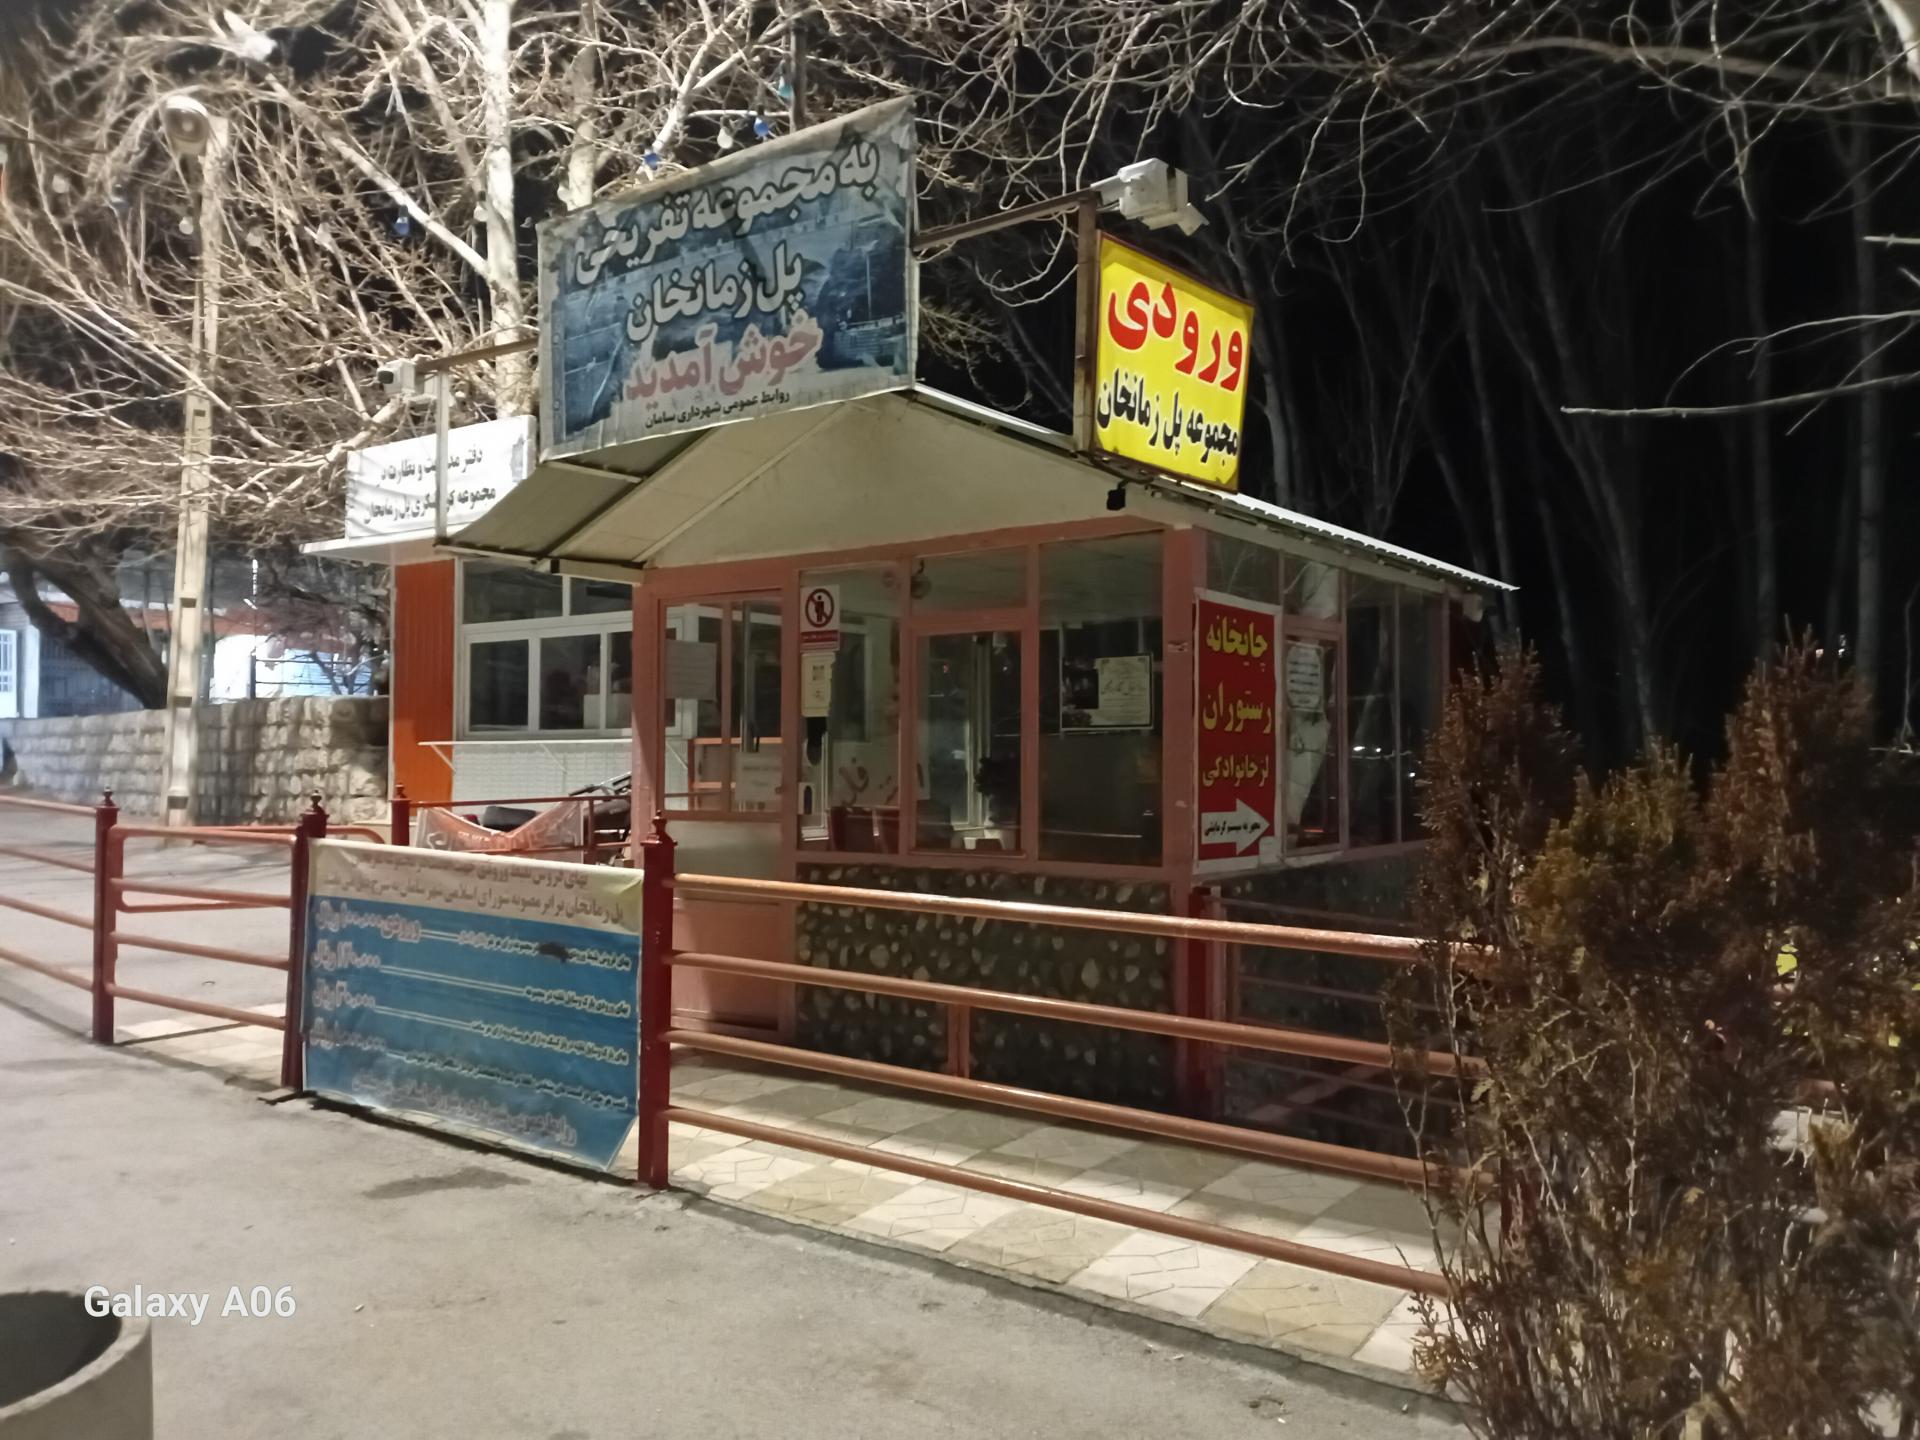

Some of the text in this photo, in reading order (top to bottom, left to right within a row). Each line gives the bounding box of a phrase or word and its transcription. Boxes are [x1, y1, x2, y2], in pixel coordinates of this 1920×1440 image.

[574, 140, 881, 285] به مجموعه تفریحی
[626, 240, 804, 344] پل زمانخان
[623, 306, 823, 411] خوش آمدید
[1107, 281, 1244, 393] ورودی
[644, 387, 791, 429] روابط عمومی شهرداری سامان
[1096, 366, 1240, 468] مجموعه پل زمانخان
[417, 463, 423, 482] و
[461, 443, 483, 474] دفتر
[457, 487, 496, 510] مجموعه
[1206, 614, 1268, 673] چایخانه
[1202, 680, 1273, 735] رستوران
